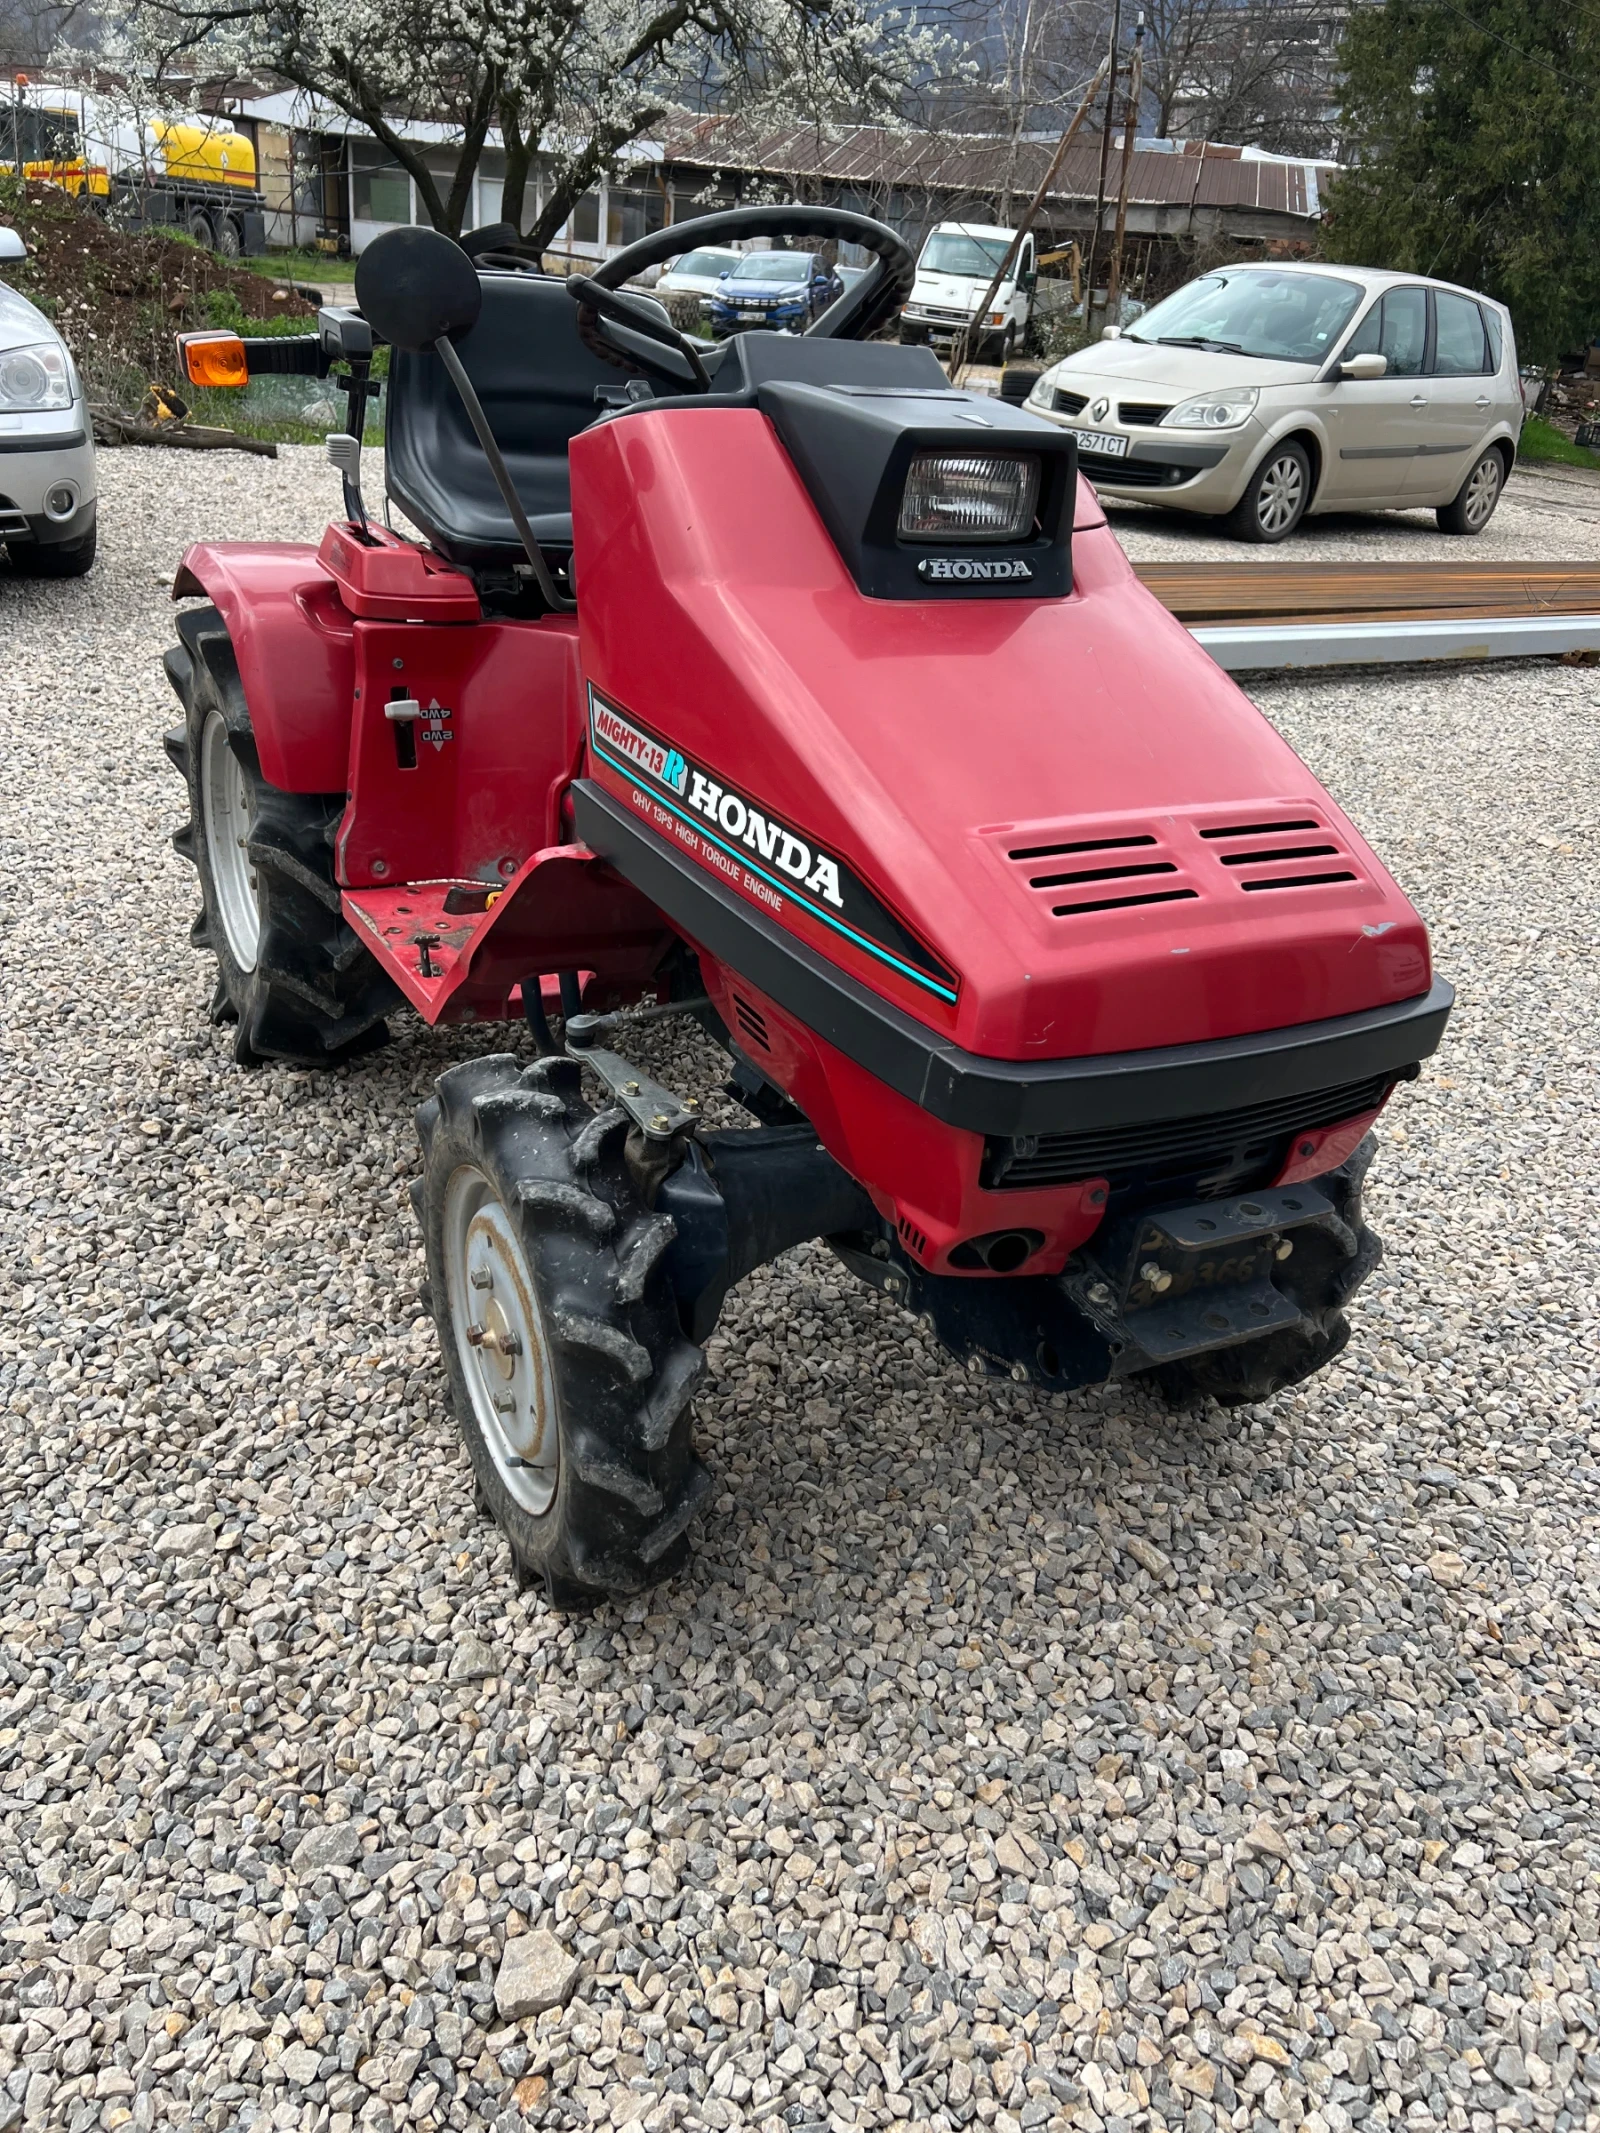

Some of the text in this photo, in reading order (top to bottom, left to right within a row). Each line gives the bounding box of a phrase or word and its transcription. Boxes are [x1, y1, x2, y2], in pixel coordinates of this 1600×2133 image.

[929, 560, 1033, 579] HONDA
[419, 709, 451, 719] 4WD
[422, 730, 453, 741] 2WD
[687, 769, 844, 908] HONDA
[632, 789, 783, 913] OHV 13PS HIGH TORQUE ENGINE
